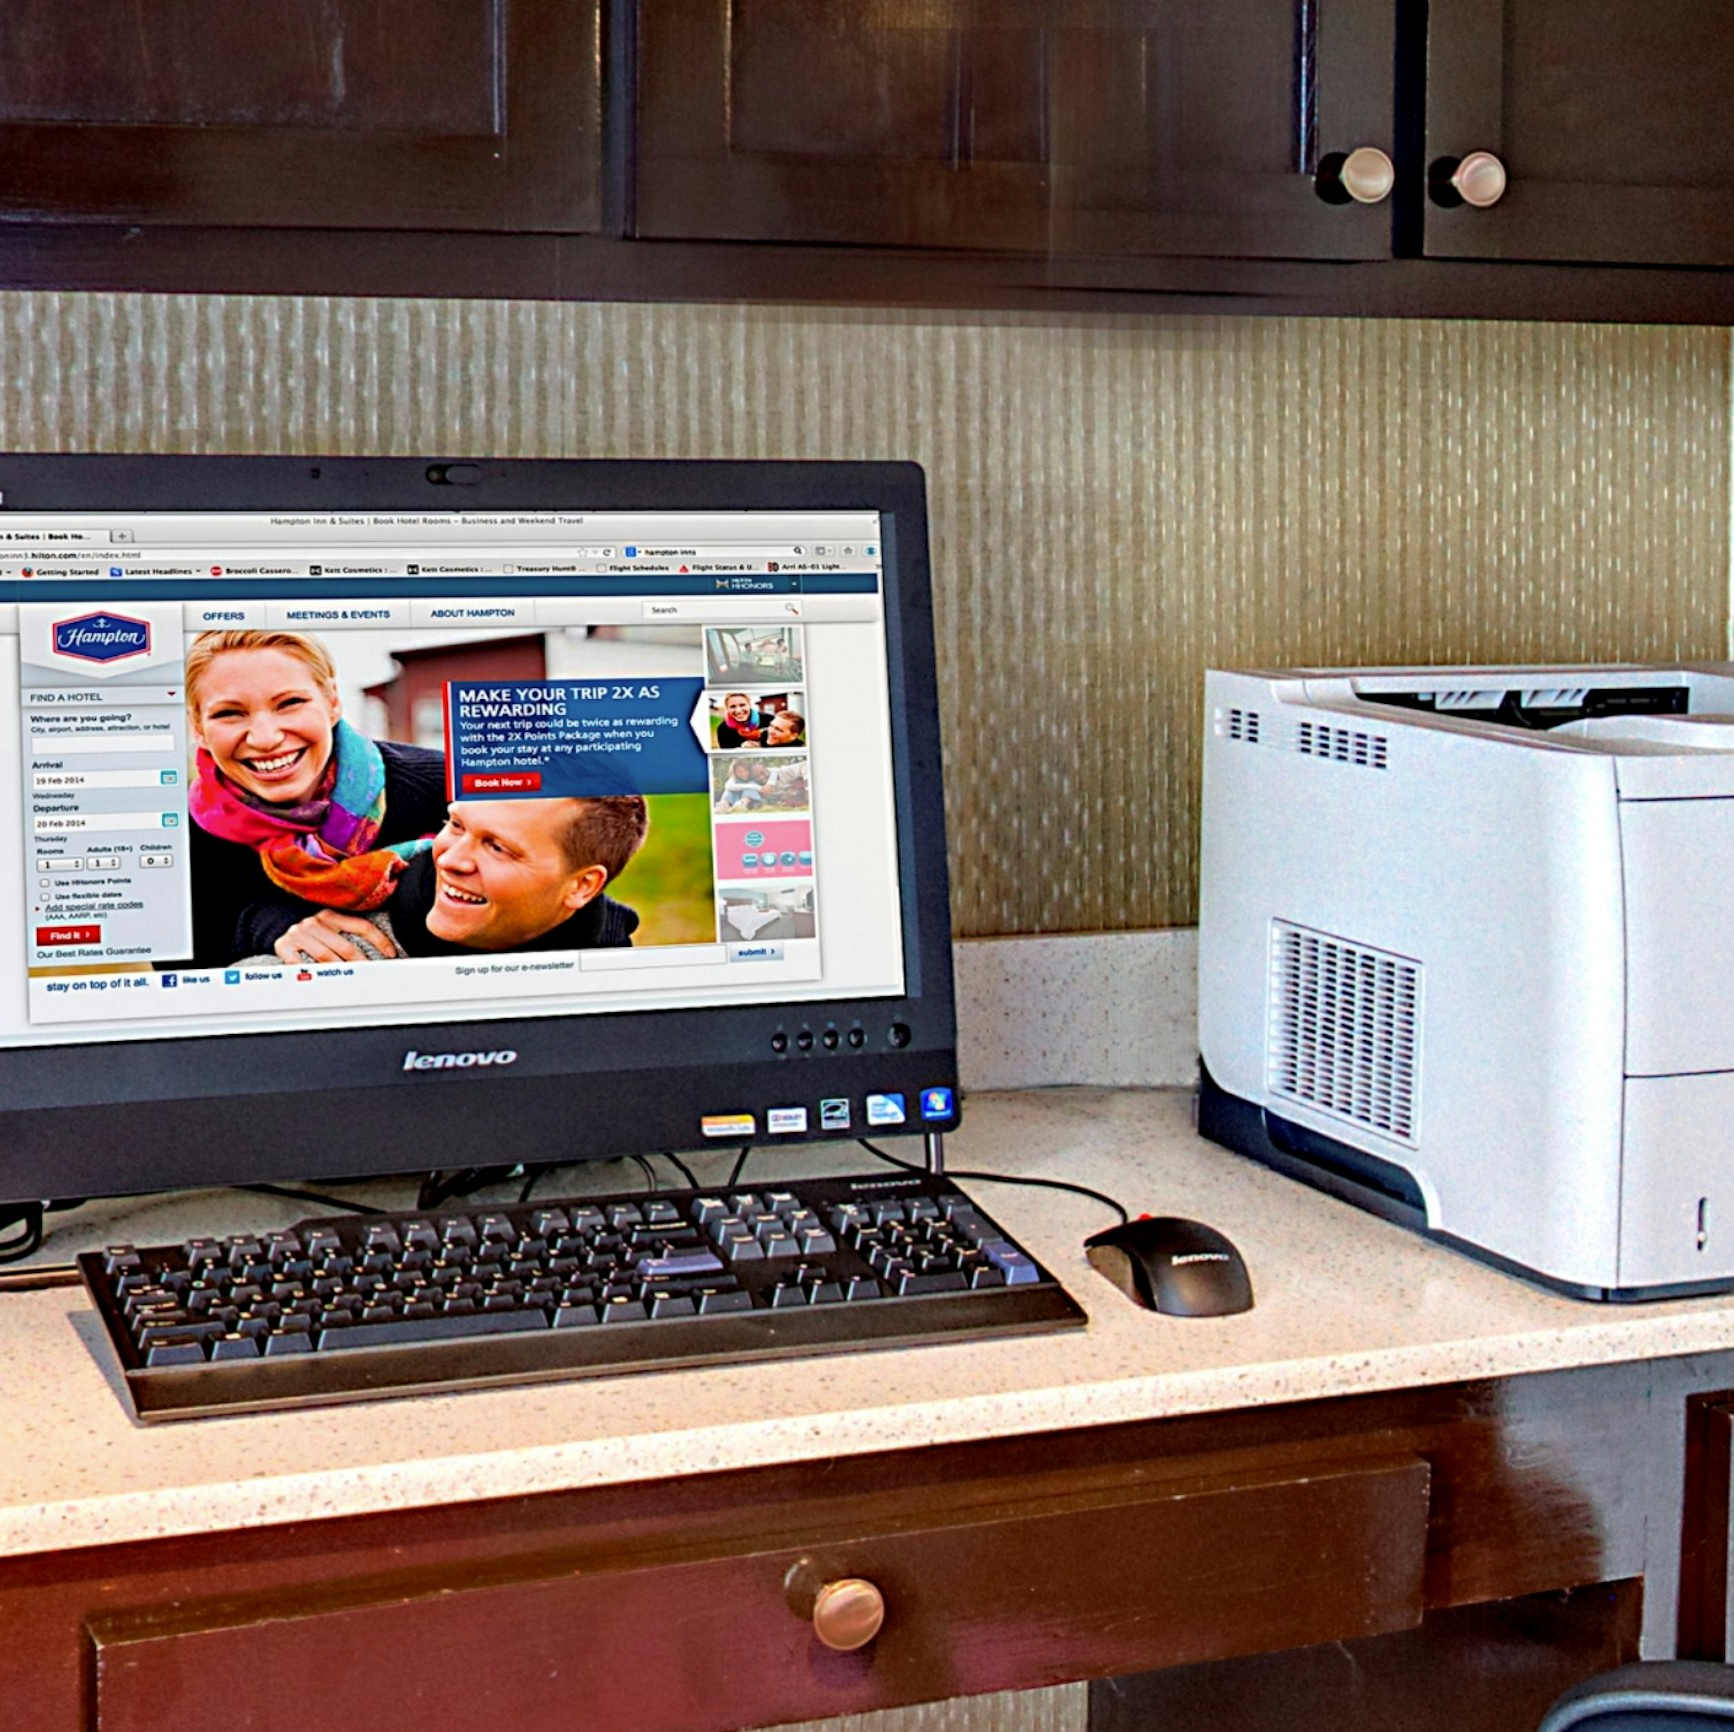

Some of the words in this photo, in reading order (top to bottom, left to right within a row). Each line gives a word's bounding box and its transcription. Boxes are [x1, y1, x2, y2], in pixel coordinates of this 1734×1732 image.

[270, 517, 310, 526] Hampton
[313, 517, 327, 525] Inn
[329, 517, 336, 525] &
[338, 517, 365, 525] Suites
[373, 517, 394, 525] Book
[397, 517, 420, 525] Hotel
[422, 517, 451, 525] Rooms
[462, 517, 497, 525] Business
[499, 517, 516, 525] and
[518, 517, 555, 525] Weekend
[558, 517, 584, 525] Travel
[6, 532, 12, 541] &
[14, 532, 40, 541] Suites
[48, 532, 67, 541] Book
[645, 548, 678, 557] hampton
[681, 548, 696, 556] inns
[36, 568, 66, 577] Getting
[69, 567, 99, 576] Started
[125, 568, 150, 576] Latest
[153, 567, 193, 576] Headlines
[226, 567, 257, 575] Broccoli
[343, 566, 383, 574] Cosmetics
[517, 566, 550, 574] Treasury
[609, 564, 631, 573] Flight
[632, 564, 669, 572] Schedules
[692, 564, 713, 572] Flight
[715, 563, 737, 571] Status
[430, 609, 464, 618] ABOUT
[467, 608, 515, 617] HAMPTON
[652, 606, 677, 614] Search
[203, 611, 245, 621] OFFERS
[287, 611, 339, 620] MEETINGS
[341, 611, 348, 619] &
[350, 610, 391, 619] EVENTS
[58, 628, 145, 648] Hampton
[30, 694, 55, 702] FIND
[67, 693, 103, 701] HOTEL
[460, 688, 512, 703] MAKE
[516, 688, 566, 702] YOUR
[570, 687, 607, 700] TRIP
[612, 687, 634, 700] 2X
[638, 685, 660, 699] AS
[460, 703, 566, 718] REWARDING
[31, 715, 60, 723] Where
[80, 716, 97, 724] you
[100, 714, 132, 723] going?
[460, 720, 484, 730] Your
[488, 721, 511, 729] next
[514, 719, 532, 730] trip
[534, 718, 564, 728] could
[566, 718, 579, 727] be
[582, 718, 610, 727] twice
[625, 716, 678, 727] rewarding
[460, 733, 484, 742] with
[487, 732, 505, 742] the
[508, 732, 522, 741] 2X
[524, 731, 557, 740] Points
[559, 730, 601, 742] Package
[603, 729, 633, 738] when
[635, 731, 654, 740] you
[461, 745, 488, 755] book
[490, 747, 514, 757] your
[517, 745, 538, 756] stay
[541, 745, 552, 753] at
[554, 745, 573, 755] any
[575, 741, 641, 754] participating
[32, 761, 63, 769] Arrival
[461, 757, 511, 768] Hampton
[474, 778, 499, 788] Book
[501, 778, 523, 787] Now
[32, 792, 75, 800] Wednesday
[33, 804, 79, 813] Departure
[66, 819, 86, 827] 2014
[34, 835, 68, 843] Thursday
[45, 903, 63, 912] Add
[65, 902, 96, 912] special
[98, 902, 115, 910] rate
[117, 901, 143, 909] codes
[50, 932, 72, 940] Find
[73, 931, 80, 939] it
[37, 950, 53, 959] Our
[55, 949, 76, 958] Best
[78, 949, 103, 957] Rates
[106, 946, 152, 956] Guarantee
[738, 947, 767, 957] submit
[317, 969, 340, 977] watch
[343, 968, 354, 976] us
[455, 966, 475, 976] Sign
[477, 967, 488, 976] up
[491, 964, 503, 973] for
[521, 961, 574, 972] e-newsletter
[183, 975, 197, 984] like
[245, 972, 269, 981] follow
[46, 981, 69, 992] stay
[73, 982, 87, 990] on
[90, 980, 108, 991] top
[110, 978, 123, 988] of
[124, 977, 132, 987] it
[134, 976, 149, 987] all.
[403, 1050, 518, 1071] lenovo
[1171, 1252, 1230, 1266] lenovo
